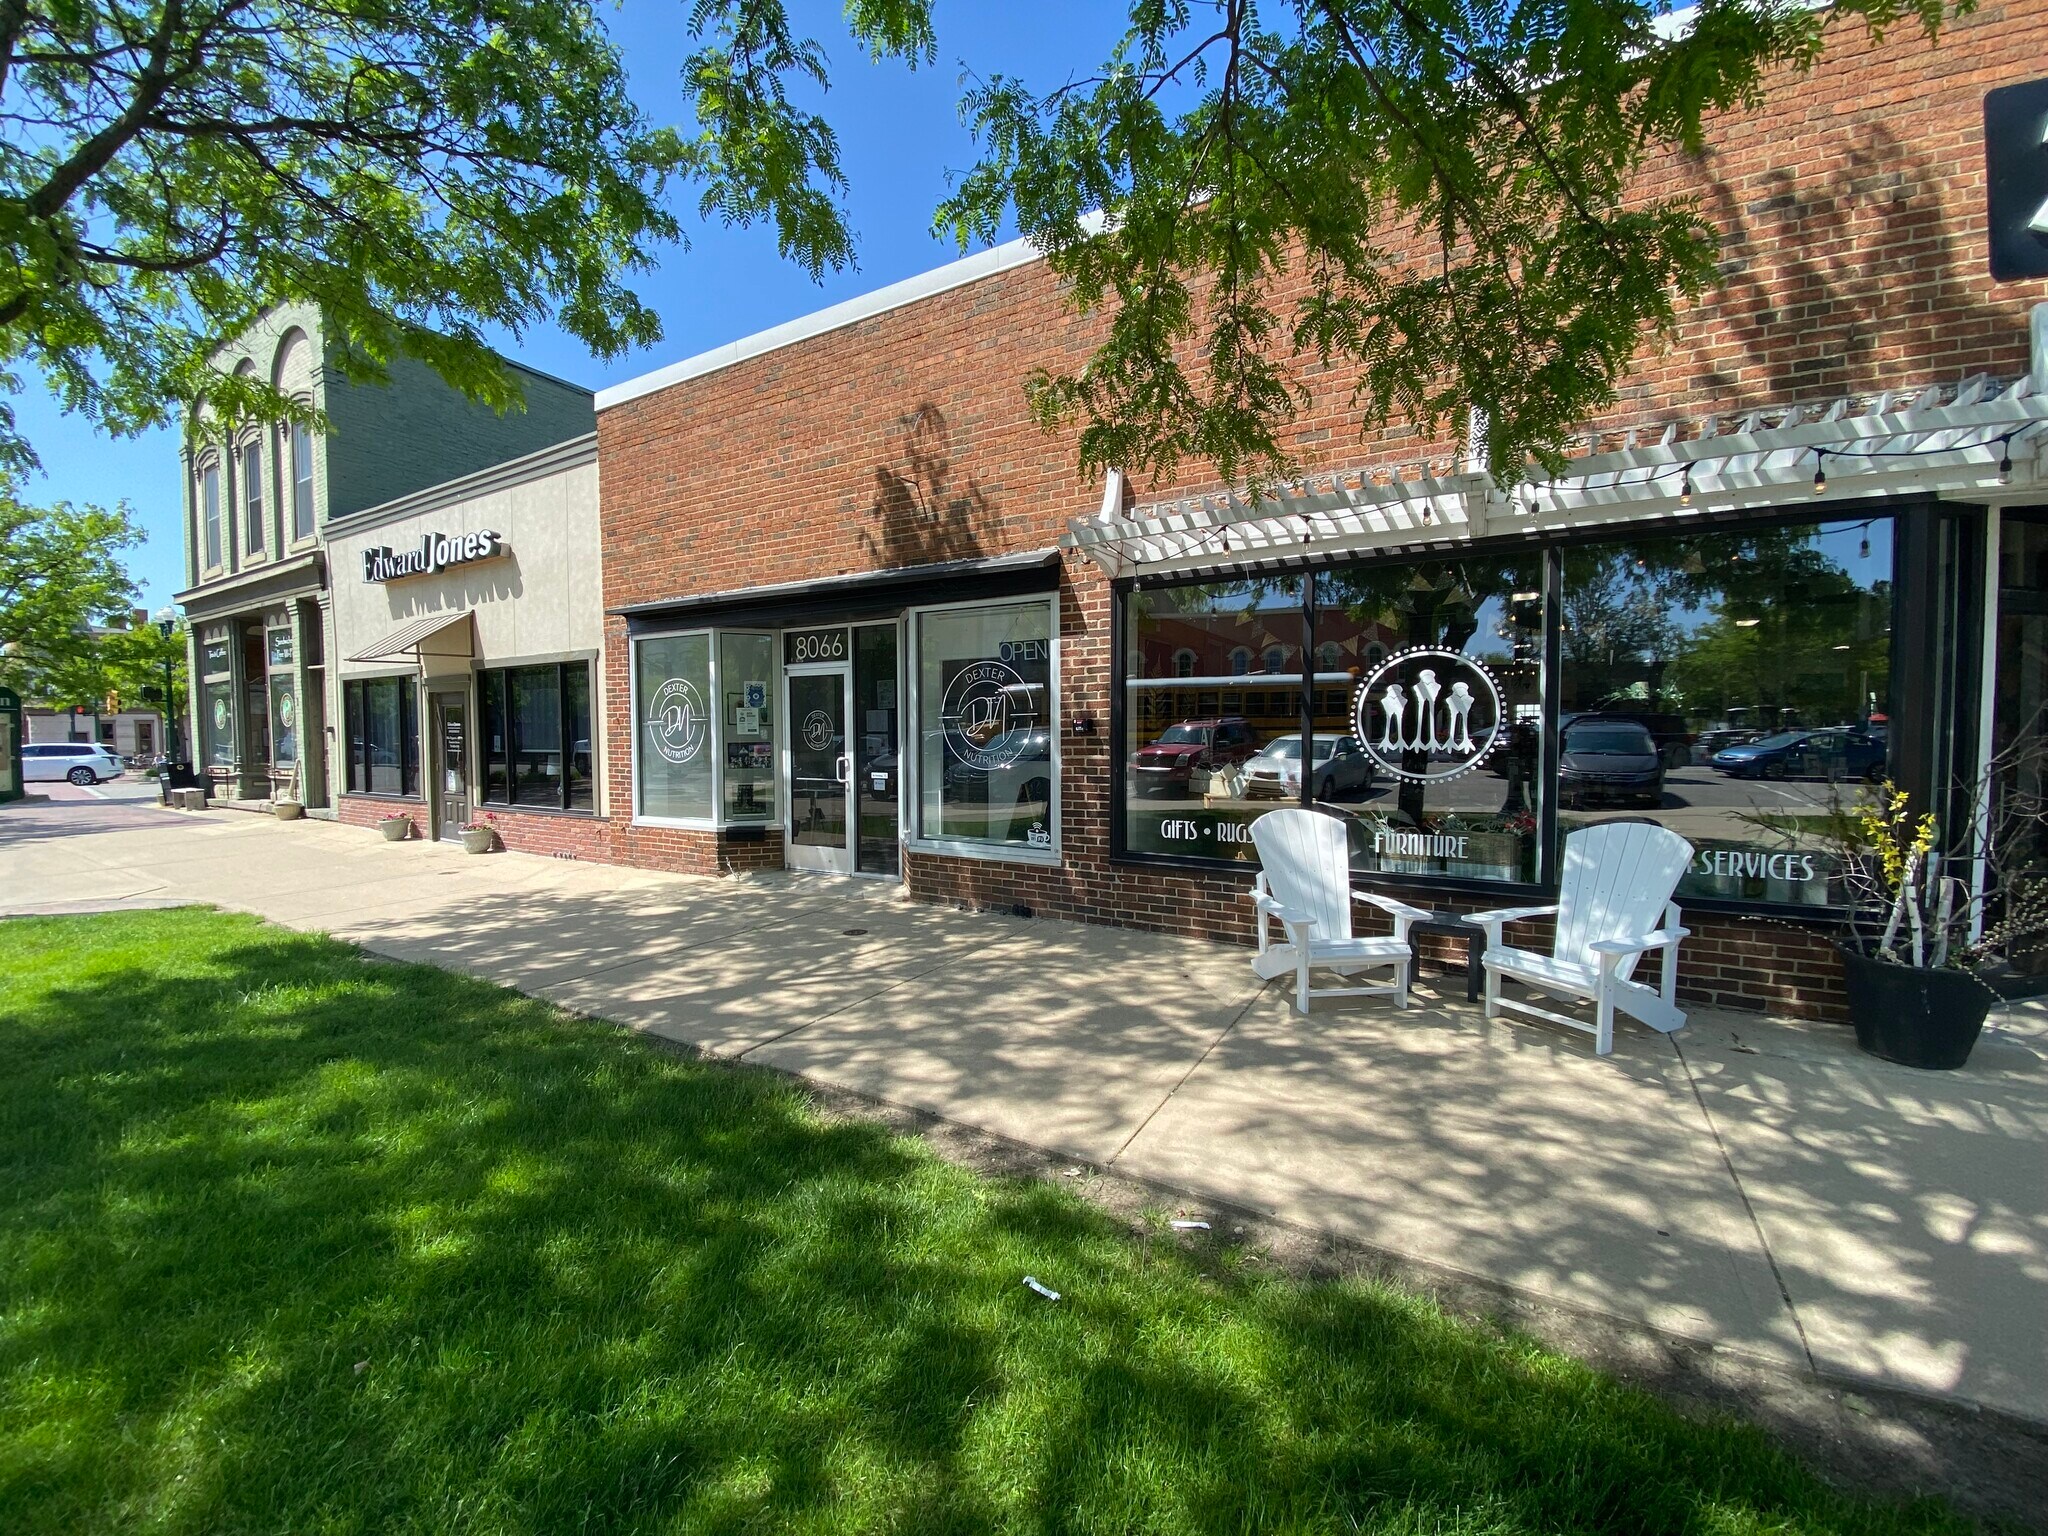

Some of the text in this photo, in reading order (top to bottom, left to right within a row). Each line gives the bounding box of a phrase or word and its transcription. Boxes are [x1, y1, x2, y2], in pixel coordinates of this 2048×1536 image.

[361, 529, 497, 583] Edward Jones
[796, 633, 843, 659] 8066
[999, 640, 1048, 661] OPEN
[965, 667, 1006, 684] DEXTER
[663, 683, 689, 696] DEXTER
[663, 744, 695, 759] NUTRITION
[963, 747, 1014, 764] NUTRITION
[1160, 819, 1198, 841] GIFTS
[1374, 831, 1469, 860] FURNITURE
[1699, 850, 1815, 881] SERVICES
